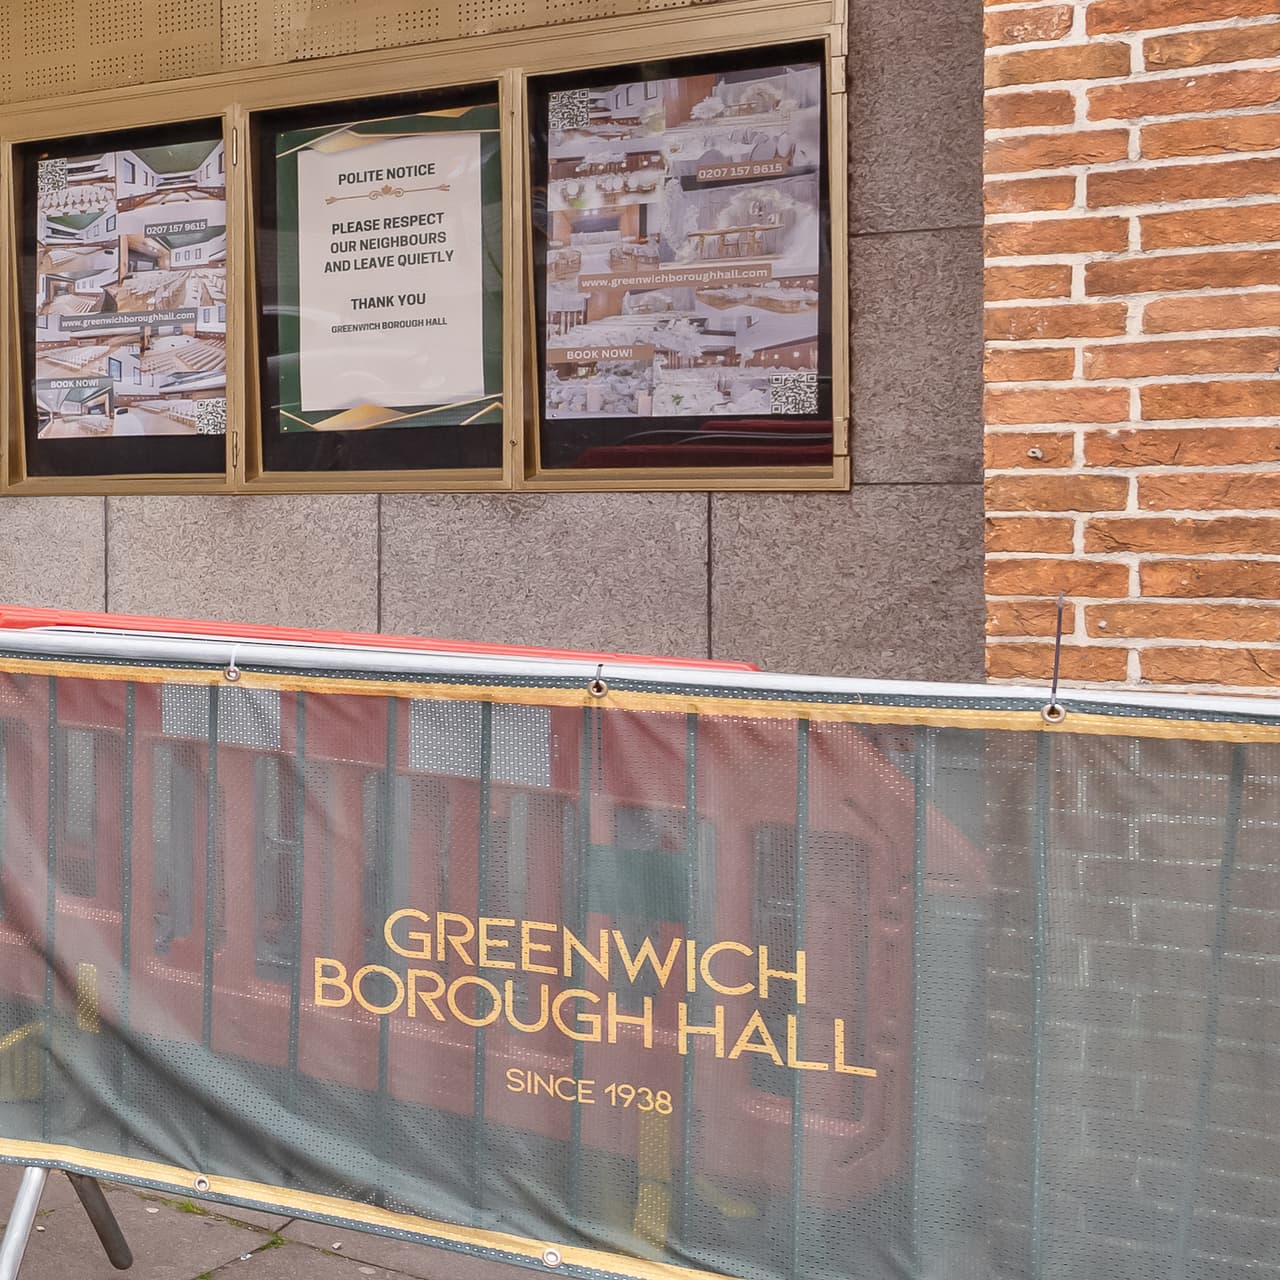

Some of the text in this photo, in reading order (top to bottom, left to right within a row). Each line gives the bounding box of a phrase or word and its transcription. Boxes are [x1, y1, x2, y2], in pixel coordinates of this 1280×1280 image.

[338, 163, 436, 186] POLITE NOTICE
[698, 163, 783, 179] 0207 157 9615
[146, 221, 206, 235] 0207 157 9615
[332, 212, 445, 235] PLEASE RESPECT
[330, 231, 447, 254] OUR NEIGHBOURS
[324, 250, 454, 273] AND LEAVE QUIETLY
[581, 270, 768, 289] www.greenwichboroughhall.com
[351, 293, 427, 310] THANK YOU
[61, 311, 196, 329] www.greenwichboroughhall.com
[331, 317, 448, 334] GREENWICH BOROUGH HALL
[566, 348, 633, 360] BOOK NOW!
[50, 378, 100, 389] BOOK NOW!
[383, 907, 807, 1005] GREENWICH
[313, 956, 878, 1078] BOROUGH HALL
[505, 1067, 674, 1116] SINCE 1938
